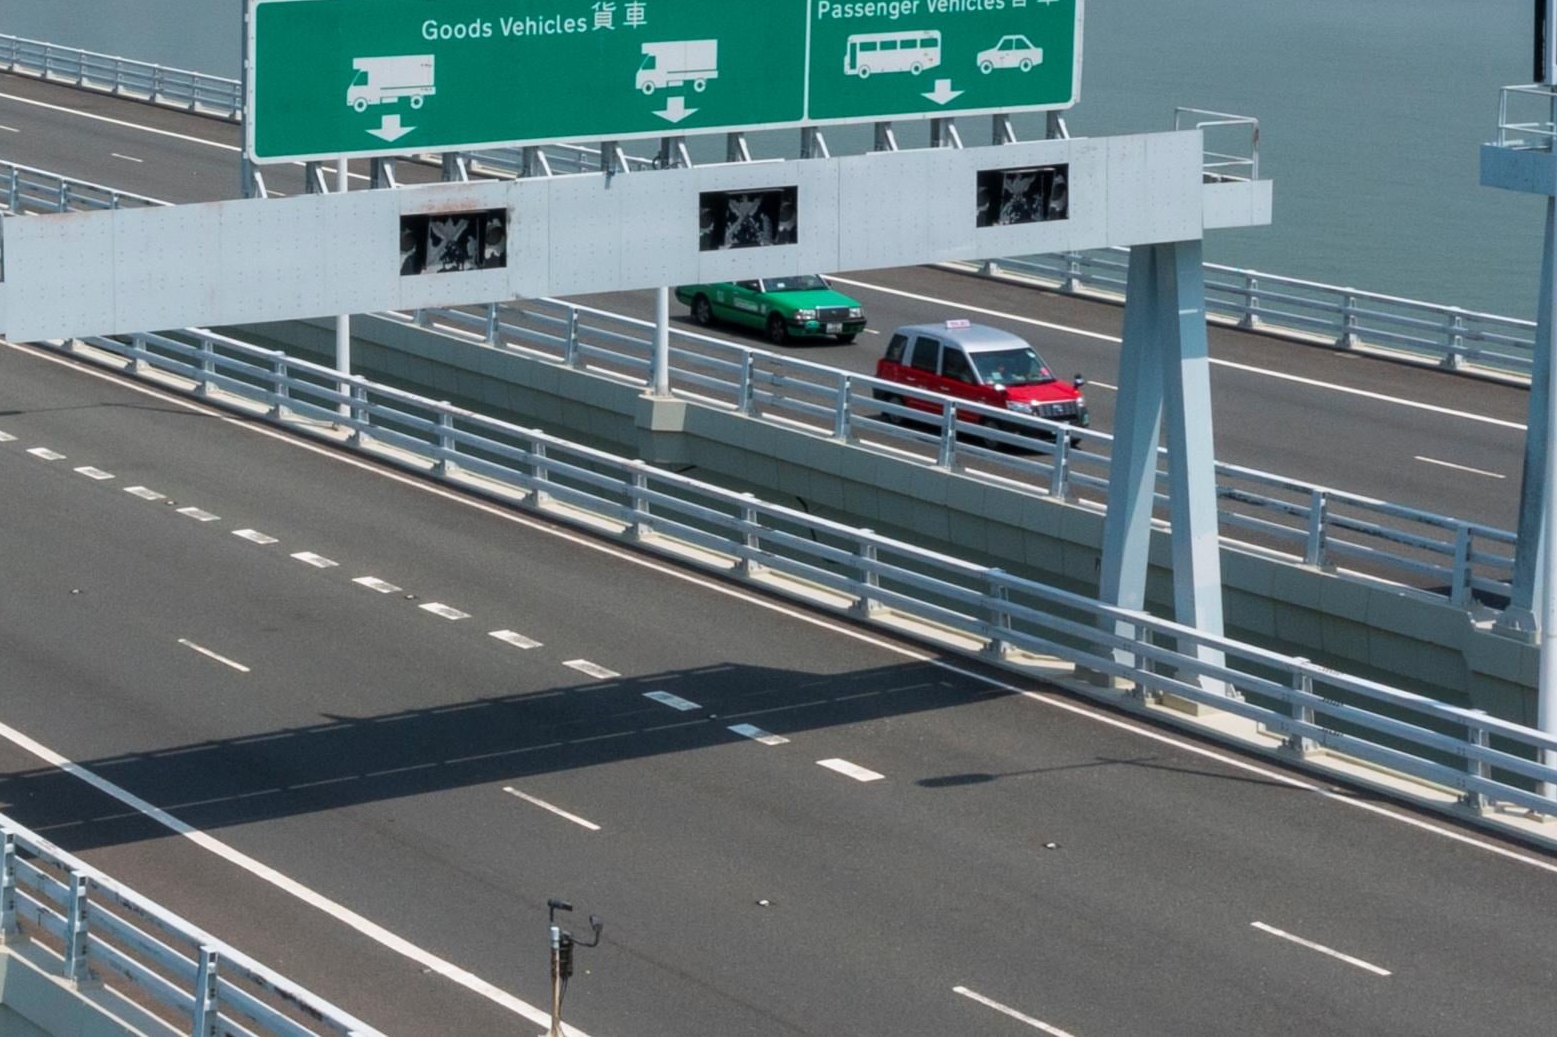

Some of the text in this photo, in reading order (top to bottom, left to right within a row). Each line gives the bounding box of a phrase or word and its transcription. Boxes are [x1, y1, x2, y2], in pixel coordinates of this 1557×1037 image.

[421, 0, 648, 41] Goods Vehicles 貨車
[817, 0, 920, 20] Passenger
